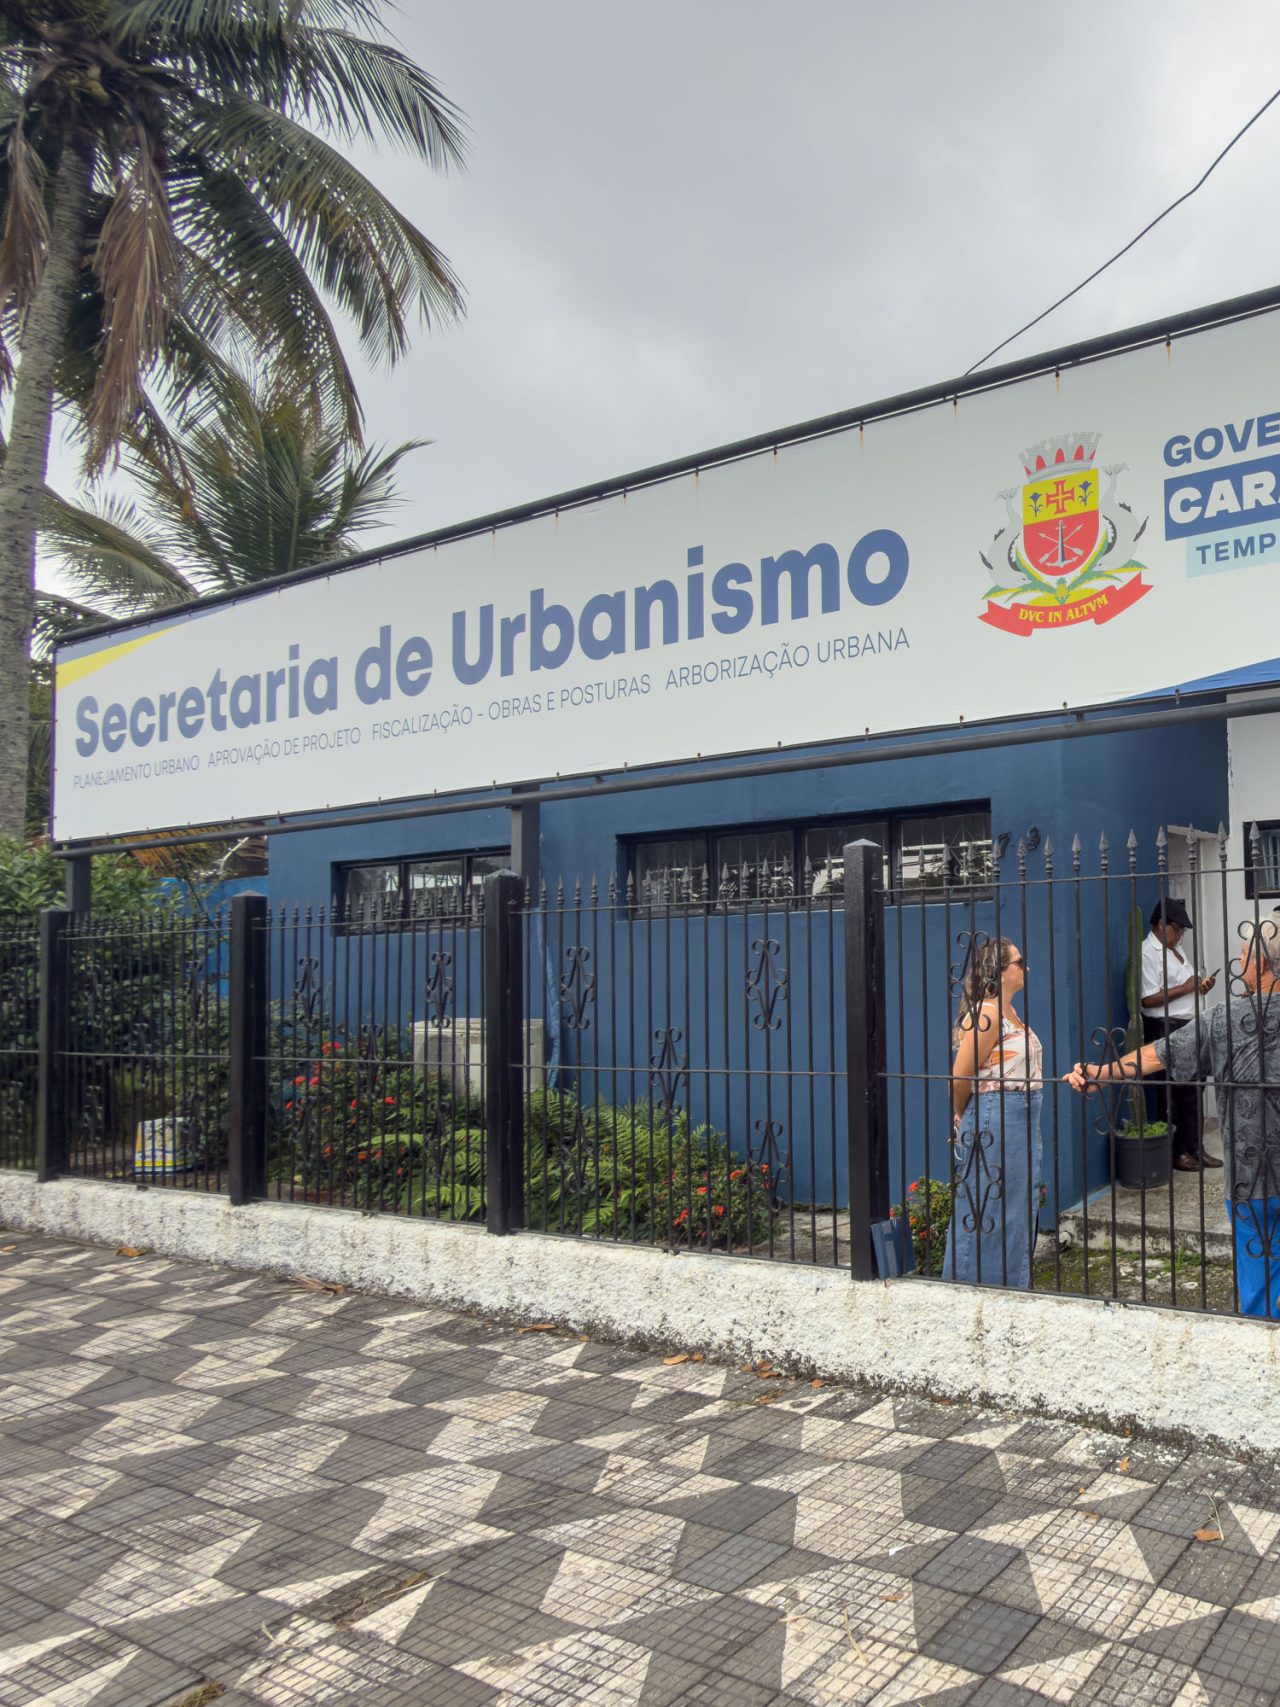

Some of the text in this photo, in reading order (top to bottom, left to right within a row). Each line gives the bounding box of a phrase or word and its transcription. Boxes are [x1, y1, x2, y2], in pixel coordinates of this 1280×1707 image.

[75, 529, 910, 758] Secretaria de Urbanismo
[1048, 611, 1063, 623] IN
[72, 761, 151, 789] PLANEJAMENTO
[153, 754, 200, 776] URBANO
[207, 738, 281, 766] APROVAÇÃO
[283, 737, 300, 756] DE
[302, 726, 361, 753] PROJETO
[371, 703, 473, 741] FISCALIZAÇÃO
[488, 694, 542, 721] OBRAS
[546, 691, 555, 711] E
[560, 674, 651, 708] POSTURAS
[665, 642, 810, 690] ARBORIZAÇÃO
[816, 627, 911, 664] URBANA
